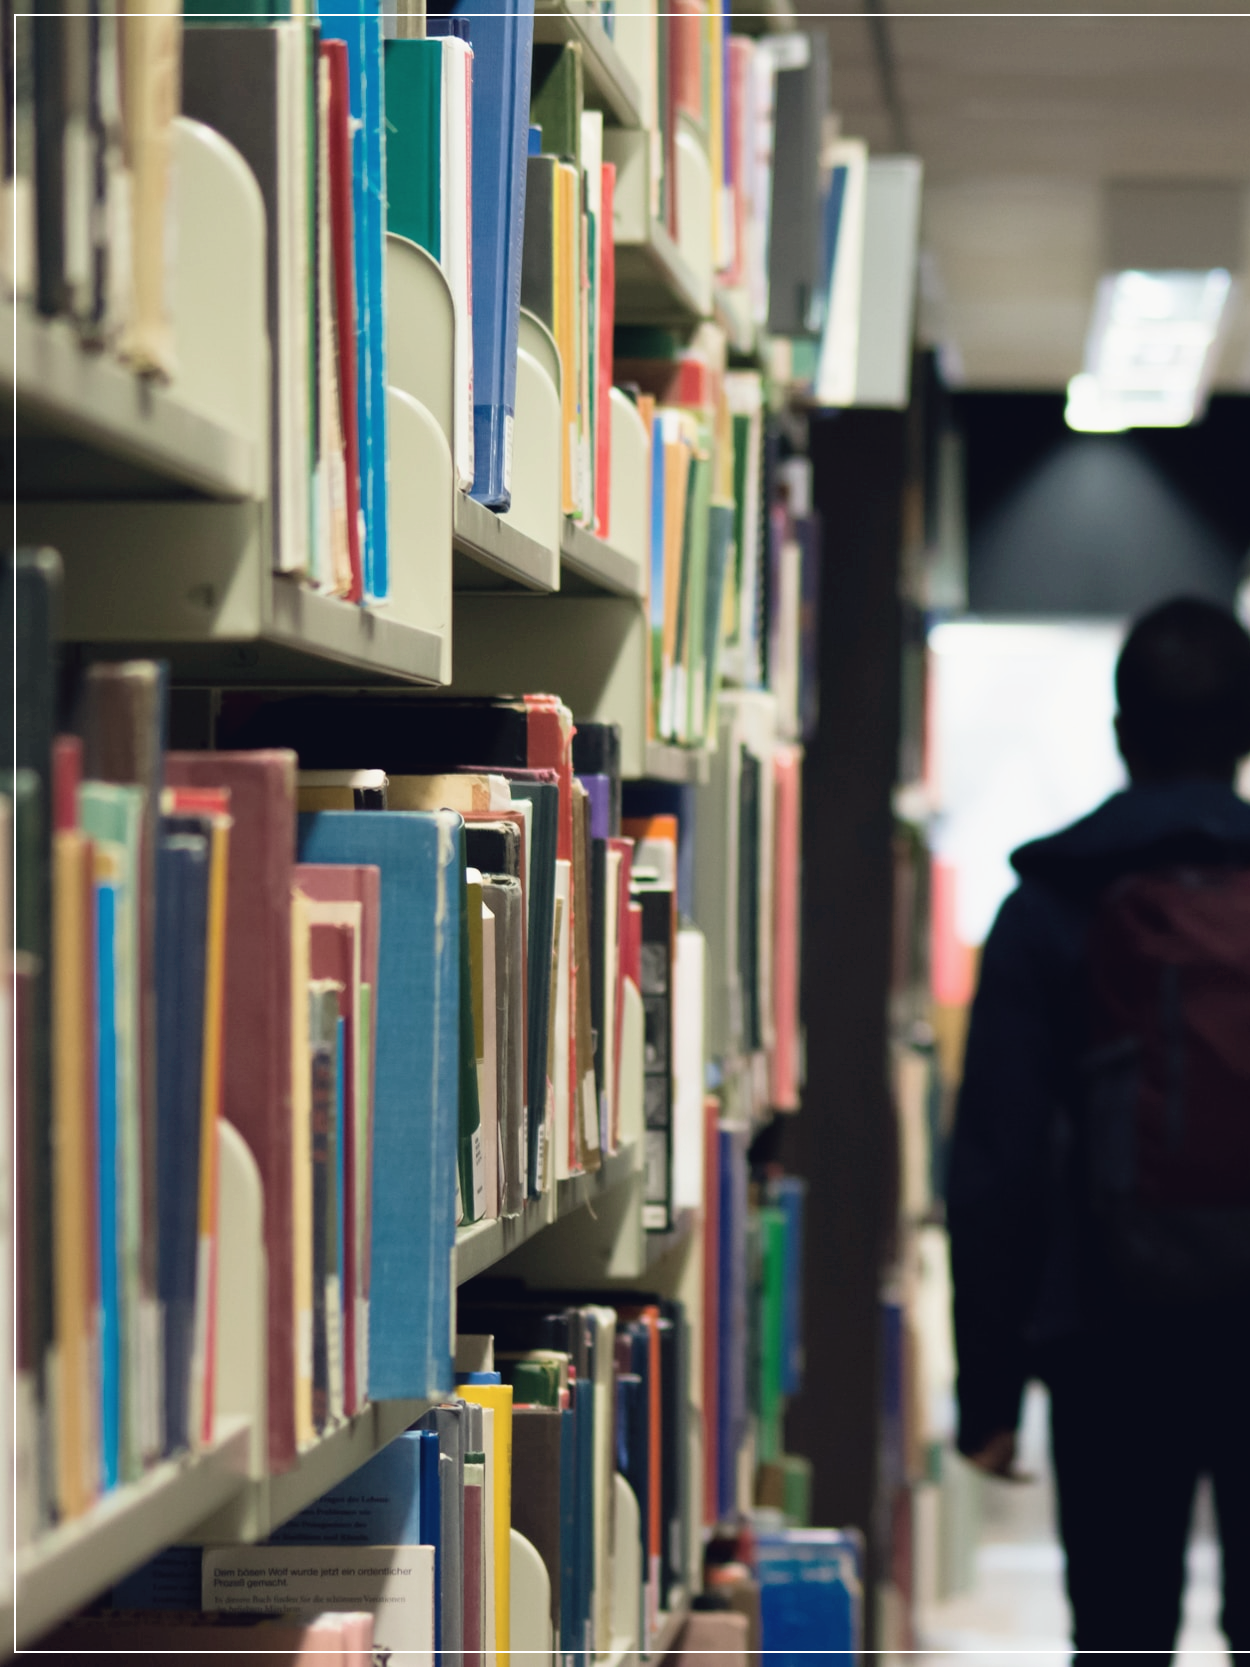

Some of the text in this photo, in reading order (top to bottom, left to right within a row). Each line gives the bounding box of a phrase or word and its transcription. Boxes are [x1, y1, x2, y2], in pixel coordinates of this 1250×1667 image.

[213, 1567, 412, 1578] Dem bösen Wolf wurde jetzt ein ordentlicher
[246, 1578, 289, 1590] gemacht.
[251, 1595, 272, 1604] Buch
[273, 1595, 300, 1604] finden
